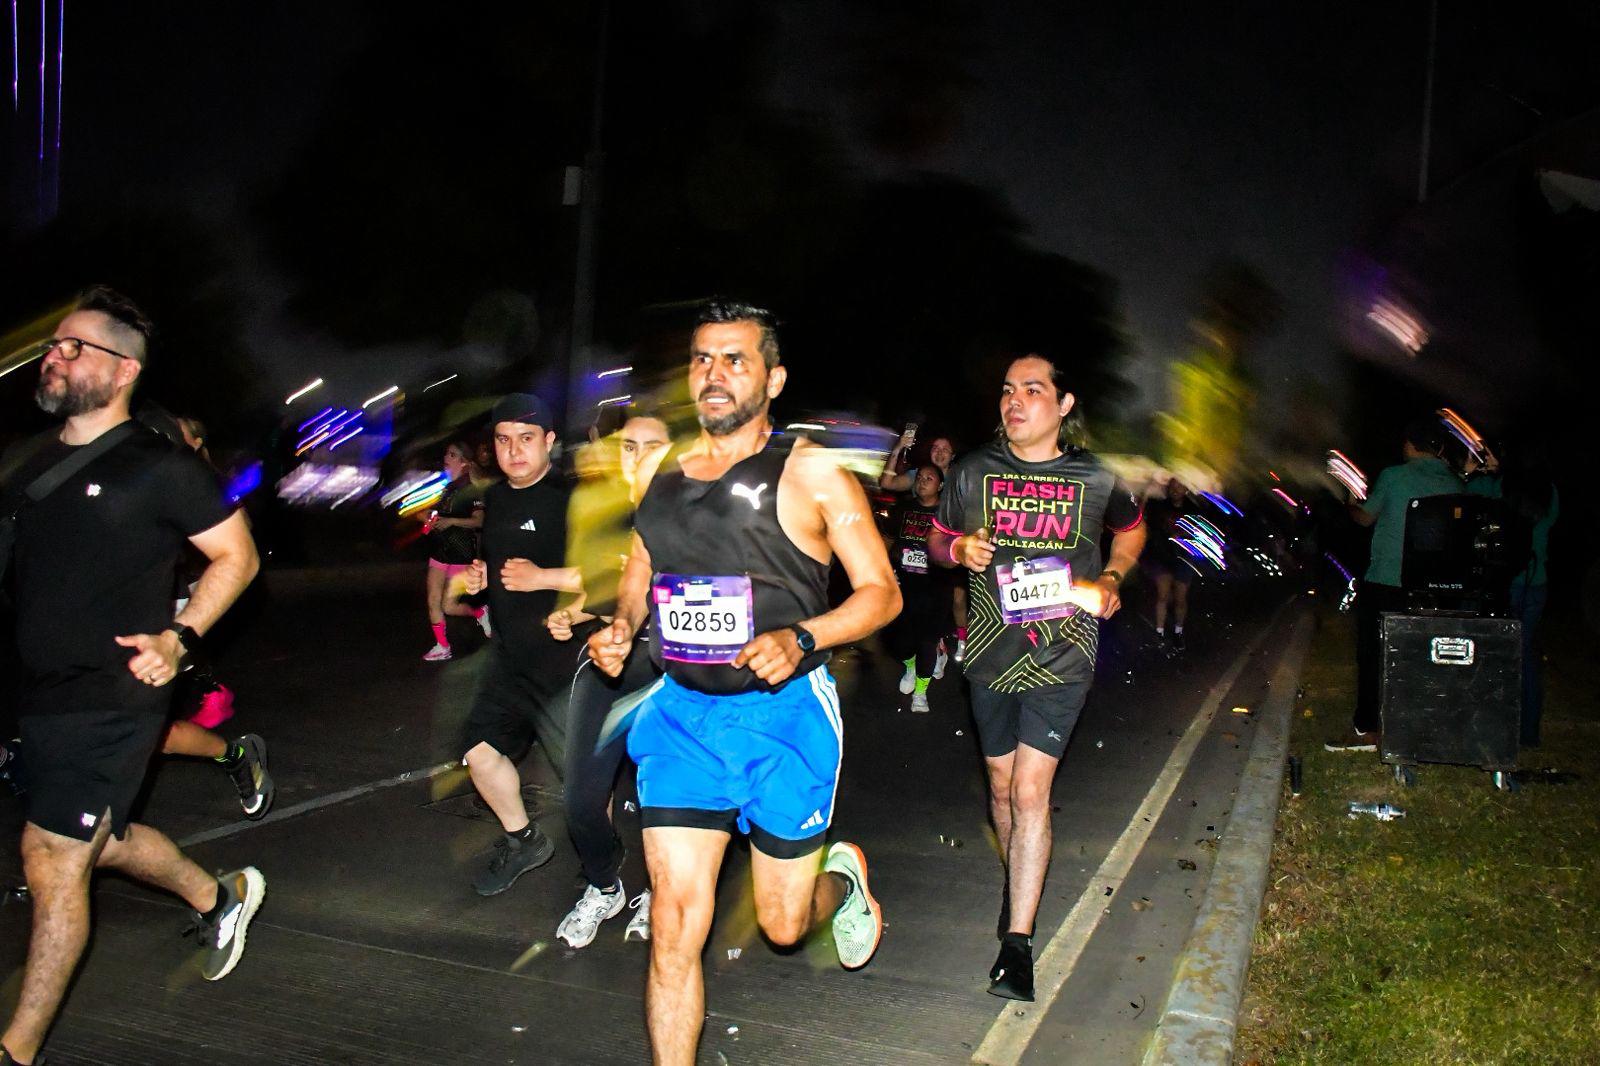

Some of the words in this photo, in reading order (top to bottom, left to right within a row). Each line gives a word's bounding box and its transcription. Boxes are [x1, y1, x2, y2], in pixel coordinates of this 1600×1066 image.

[992, 480, 1075, 501] FLASH
[991, 497, 1074, 515] NIGHT
[995, 510, 1072, 540] RUN
[997, 539, 1063, 550] CULIACÁN
[1010, 582, 1060, 602] 04472
[669, 610, 736, 632] 02859
